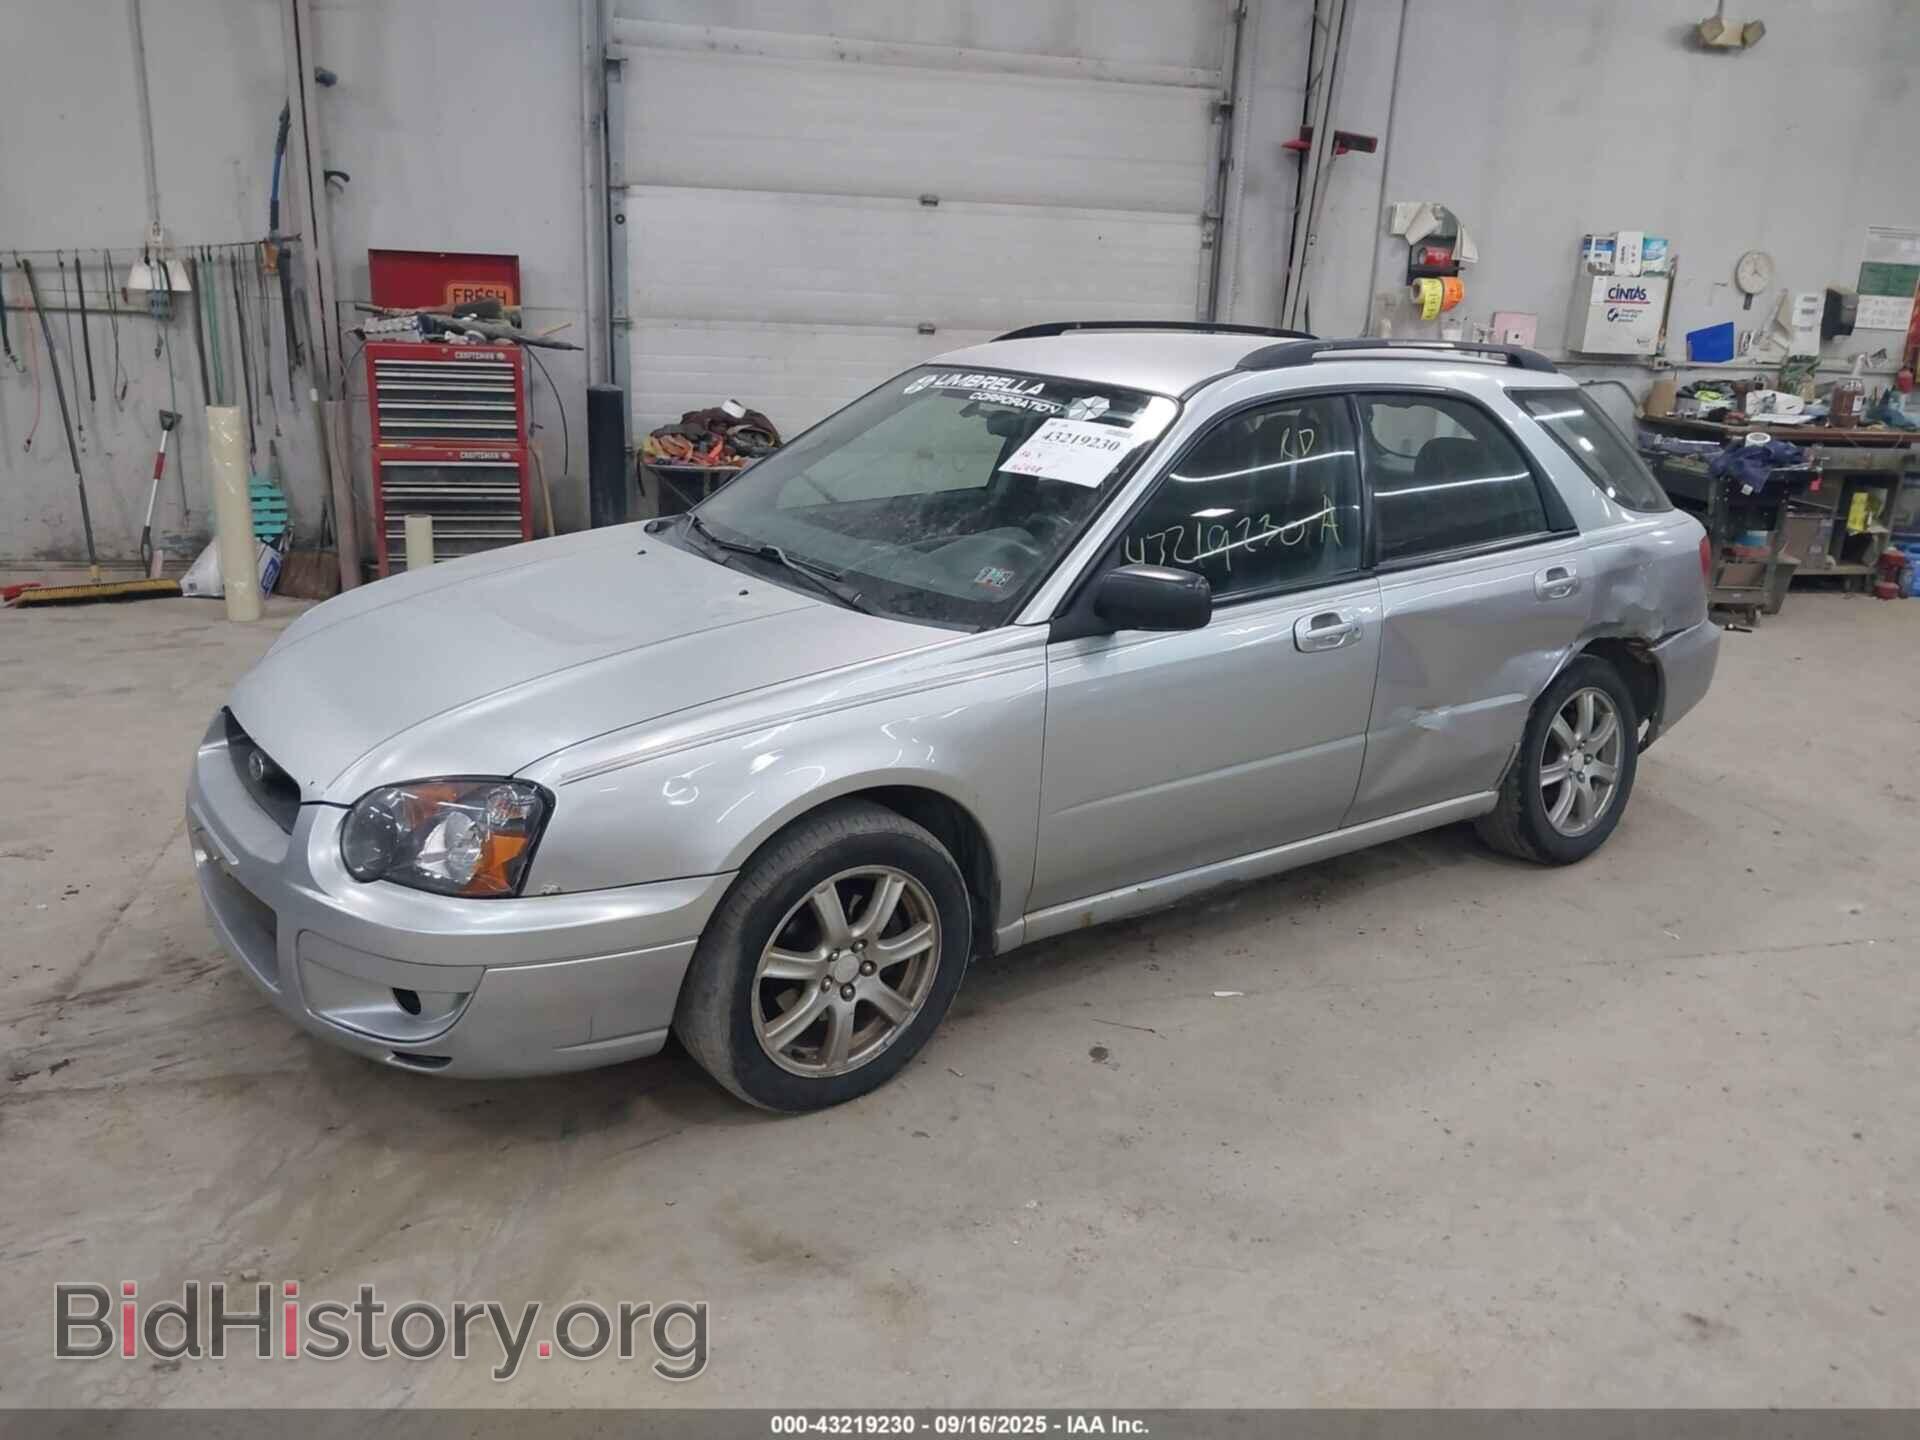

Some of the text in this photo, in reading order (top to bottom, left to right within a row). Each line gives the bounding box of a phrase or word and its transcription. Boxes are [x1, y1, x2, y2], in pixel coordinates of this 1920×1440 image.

[1607, 283, 1647, 300] CINTAS
[934, 373, 1046, 396] UMBRELLA
[969, 391, 1062, 414] CORPORATION
[1043, 431, 1121, 452] 43219230
